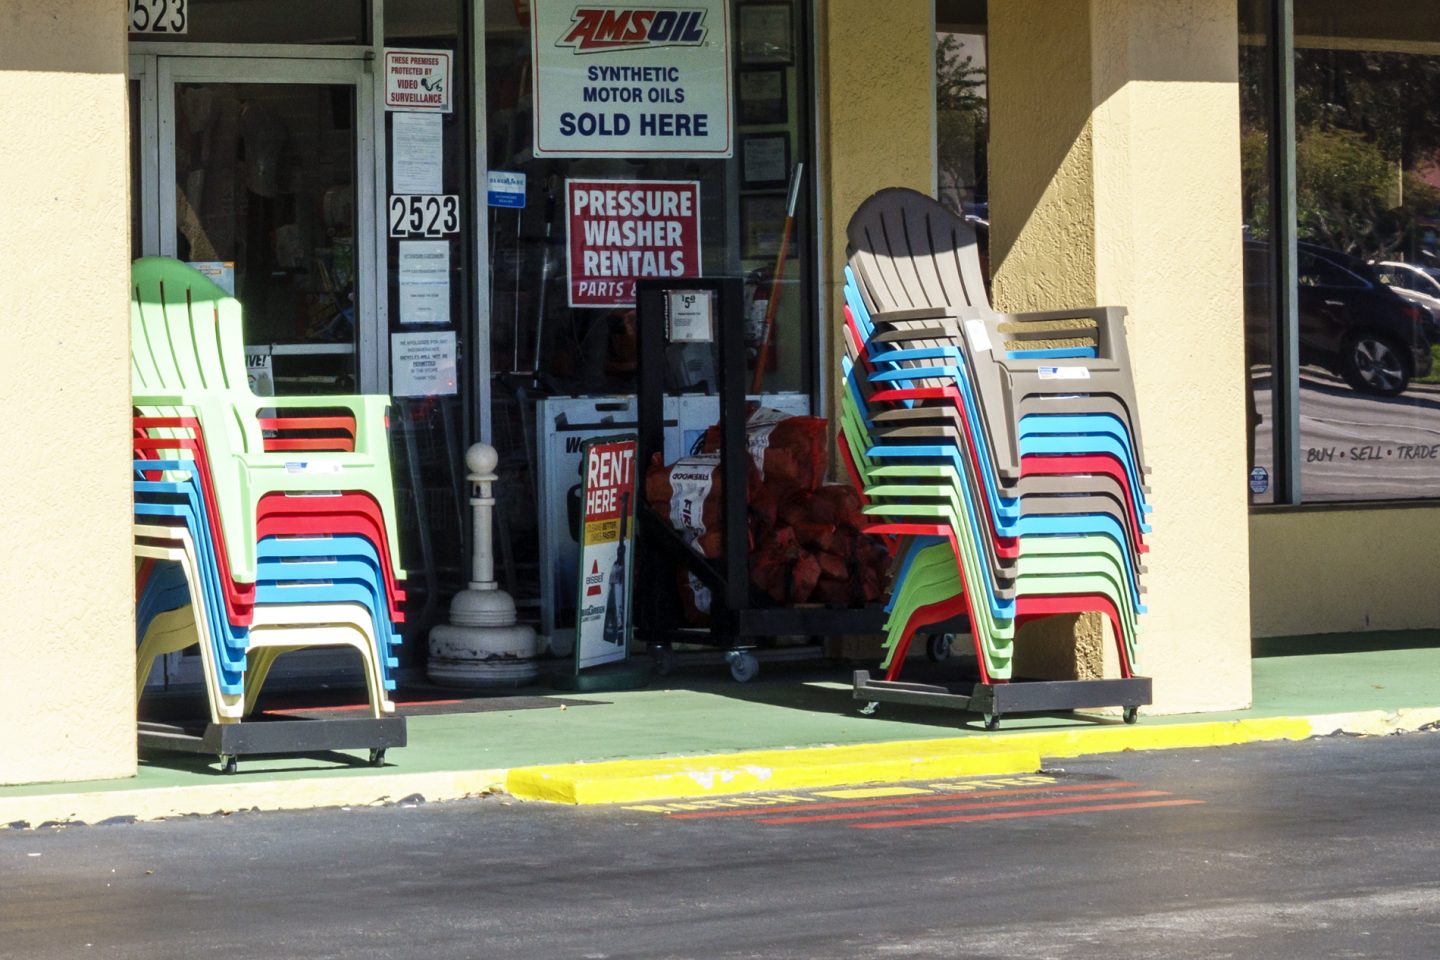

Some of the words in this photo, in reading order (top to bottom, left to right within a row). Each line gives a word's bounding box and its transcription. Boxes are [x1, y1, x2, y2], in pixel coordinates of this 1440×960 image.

[563, 8, 710, 50] AMSOIL
[391, 56, 409, 65] THESE
[410, 57, 440, 66] PREMISES
[391, 66, 424, 76] PROTECTED
[424, 67, 433, 75] BY
[397, 79, 418, 89] VIDEO
[587, 66, 679, 82] SYNTHETIC
[391, 92, 442, 103] SURVEILLANCE
[583, 87, 643, 103] MOTOR
[647, 87, 685, 104] OILS
[559, 112, 631, 136] SOLD
[639, 113, 709, 137] HERE
[574, 190, 692, 217] PRESSURE
[391, 196, 458, 236] 2523
[583, 220, 683, 247] WASHER
[583, 250, 685, 278] RENTALS
[578, 281, 624, 297] PARTS
[1306, 446, 1336, 463] BUY
[1350, 445, 1384, 461] SELL
[1397, 443, 1440, 460] TRADE
[587, 448, 634, 489] RENT
[586, 488, 617, 515] HERE
